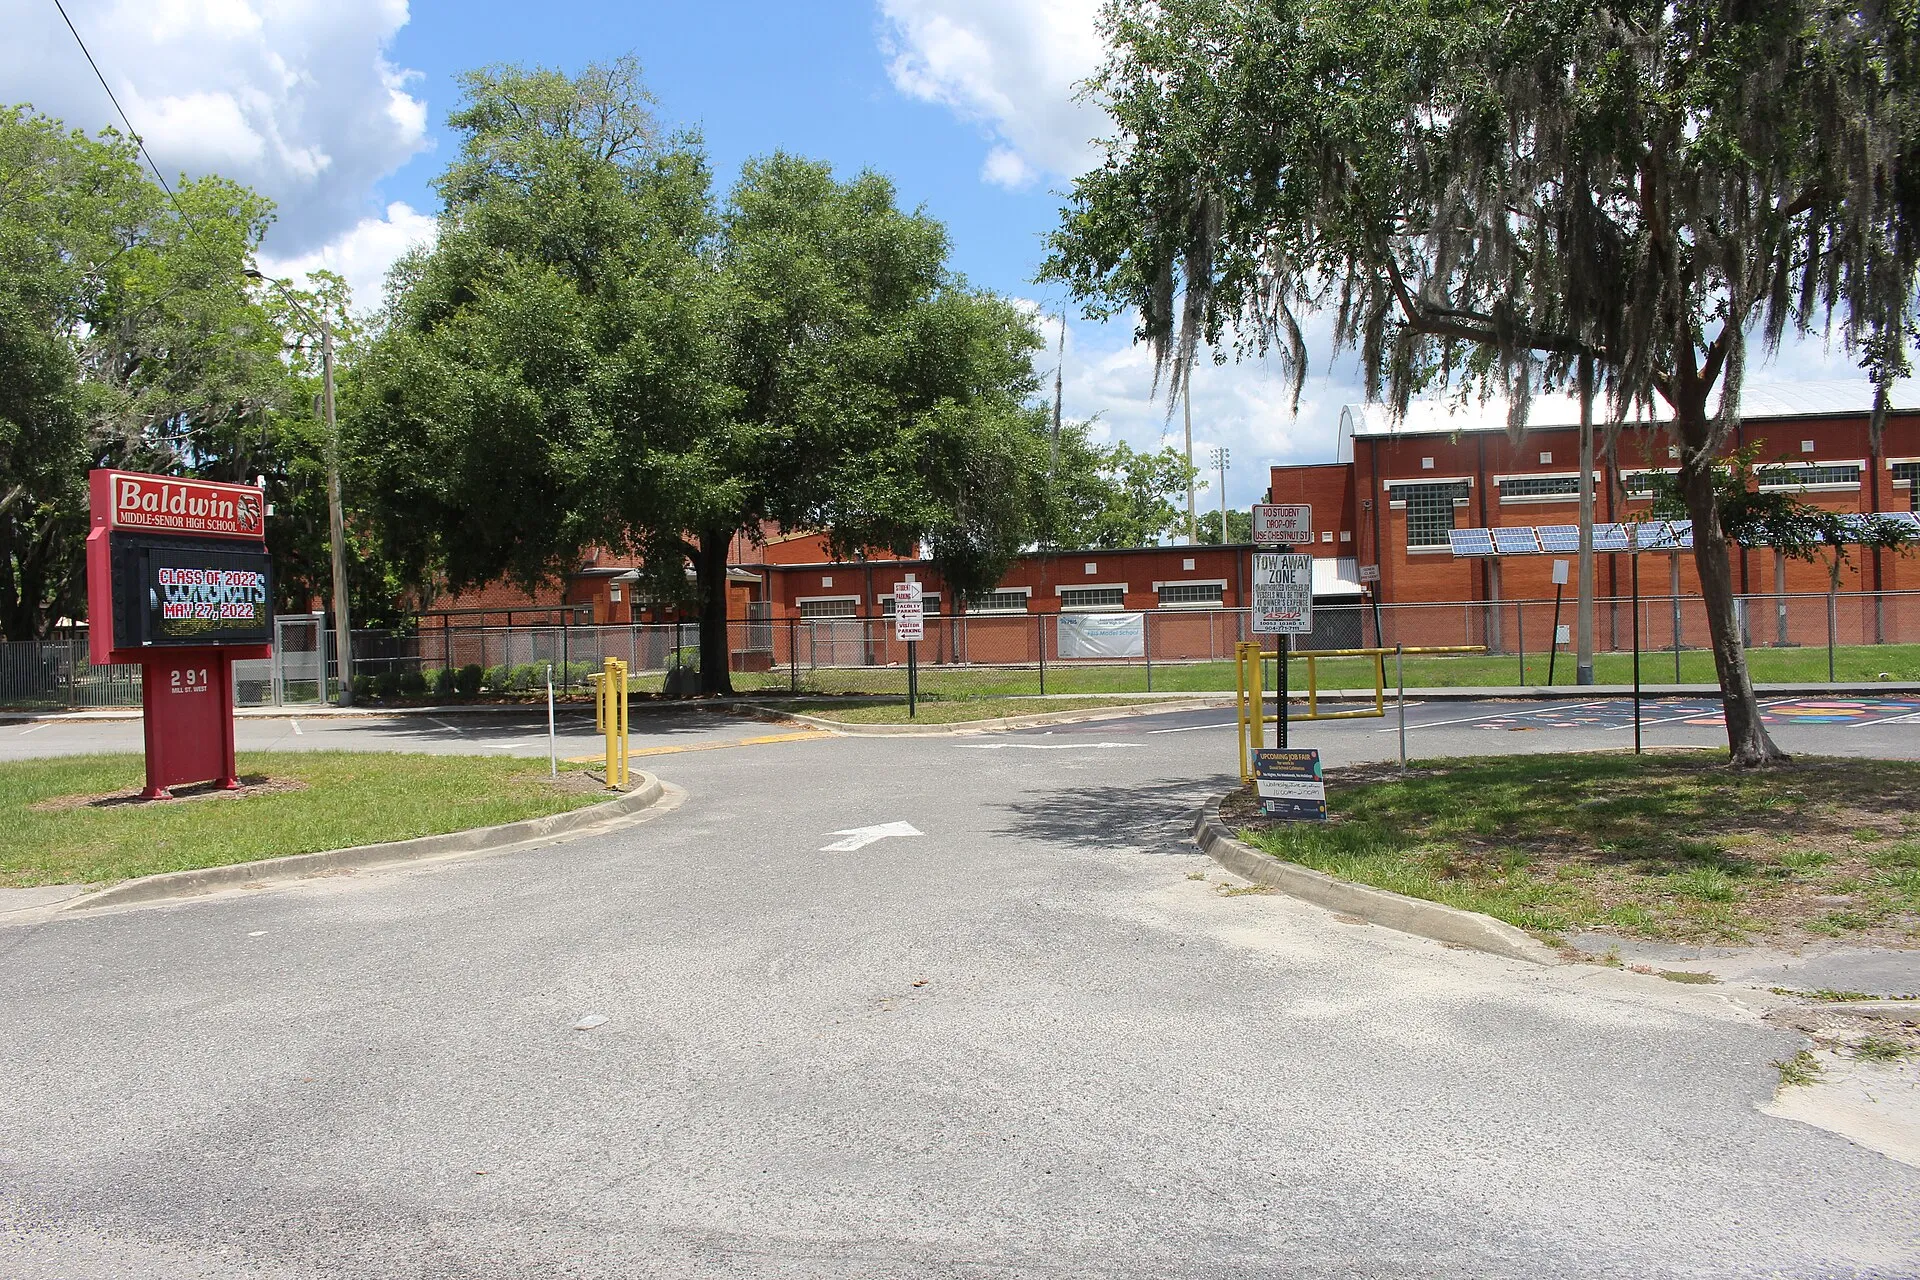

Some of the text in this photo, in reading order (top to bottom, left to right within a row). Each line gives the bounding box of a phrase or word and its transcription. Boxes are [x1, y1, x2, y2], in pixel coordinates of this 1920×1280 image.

[119, 481, 234, 519] Baldwin
[1263, 508, 1300, 517] NO STUDENT
[120, 511, 238, 532] MIDDLE-SENIOR HIGH SCHOOL
[1266, 519, 1297, 529] DROP-OFF
[1255, 531, 1308, 540] USE CHESTNUT ST
[1255, 555, 1310, 570] TOW AWAY
[159, 569, 257, 588] CLASS OF 2022
[1268, 569, 1297, 584] ZONE
[1256, 591, 1309, 599] VESSELS WILL BE TOWED
[1263, 599, 1286, 607] OWNER'S
[1286, 599, 1308, 607] EXPENSE
[165, 603, 254, 620] MAY 27, 2022
[1263, 611, 1301, 619] ASAP
[1288, 753, 1298, 761] JOB
